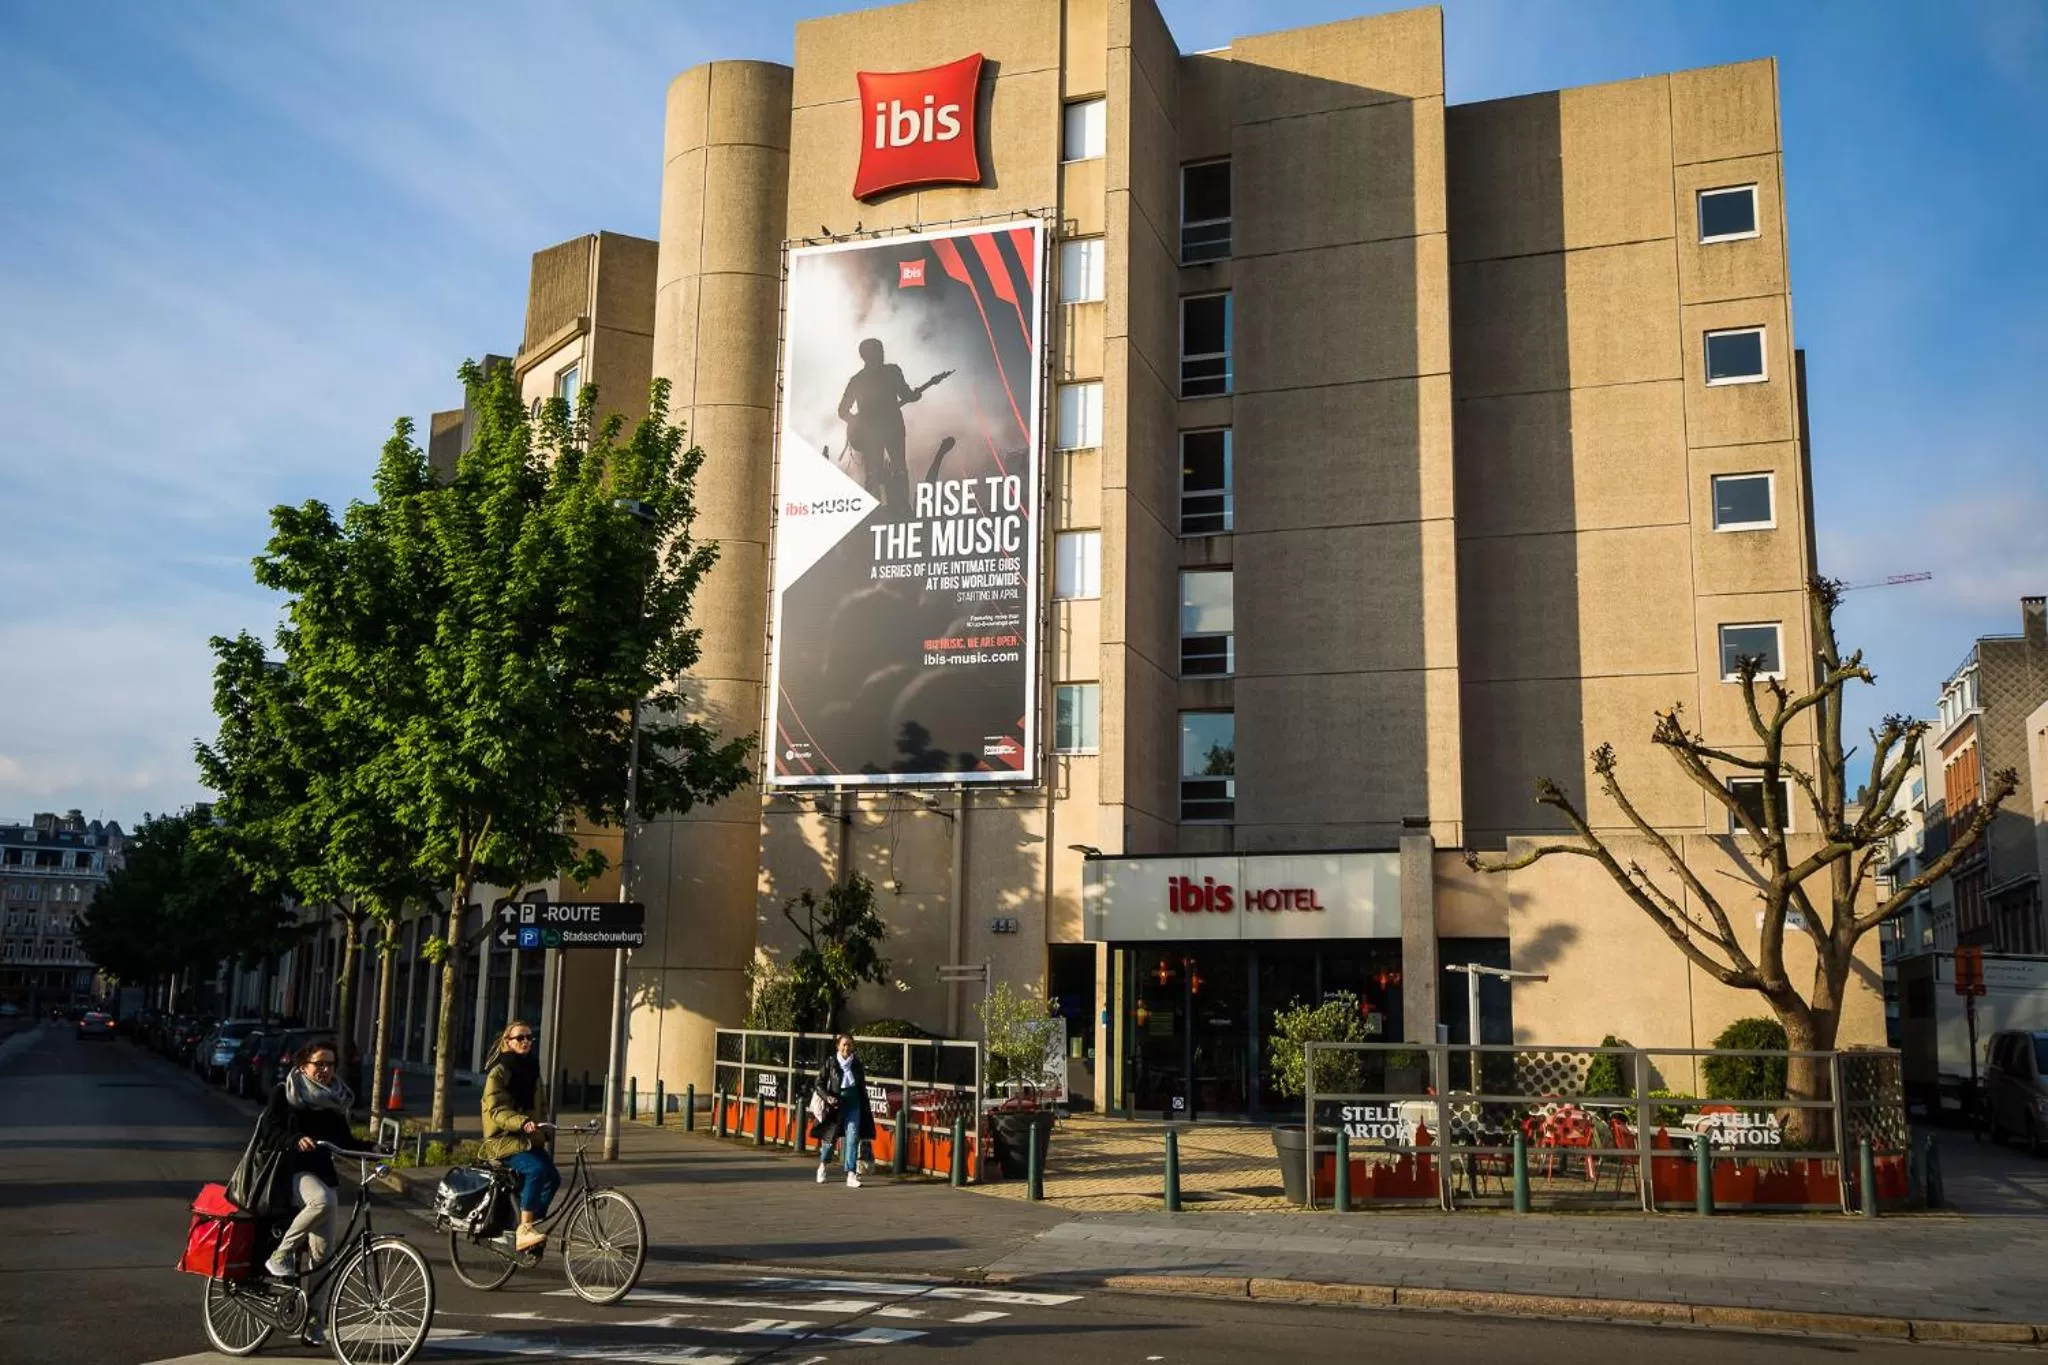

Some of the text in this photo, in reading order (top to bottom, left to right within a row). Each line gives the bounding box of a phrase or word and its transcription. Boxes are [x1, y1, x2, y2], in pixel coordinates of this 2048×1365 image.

[875, 95, 960, 149] ibis
[916, 475, 1021, 519] RISE TO
[785, 498, 862, 516] ibis MUSIC
[870, 515, 1021, 560] THE MUSIC
[870, 566, 878, 579] A
[879, 563, 912, 579] SERIES
[914, 562, 926, 577] OF
[928, 561, 949, 576] LIVE
[951, 559, 996, 574] INTIMATE
[926, 572, 1021, 591] AT IBIS WORLDWIDE
[957, 588, 1020, 602] STARTING IN APRIL
[924, 651, 1019, 665] ibis-music.com
[1168, 876, 1324, 913] ibis HOTEL
[563, 930, 643, 944] Stadsschouwburg
[865, 1086, 887, 1100] TELLA
[1342, 1106, 1400, 1122] STELL
[1711, 1112, 1779, 1128] STELLA
[1710, 1128, 1781, 1145] ARTOIS
